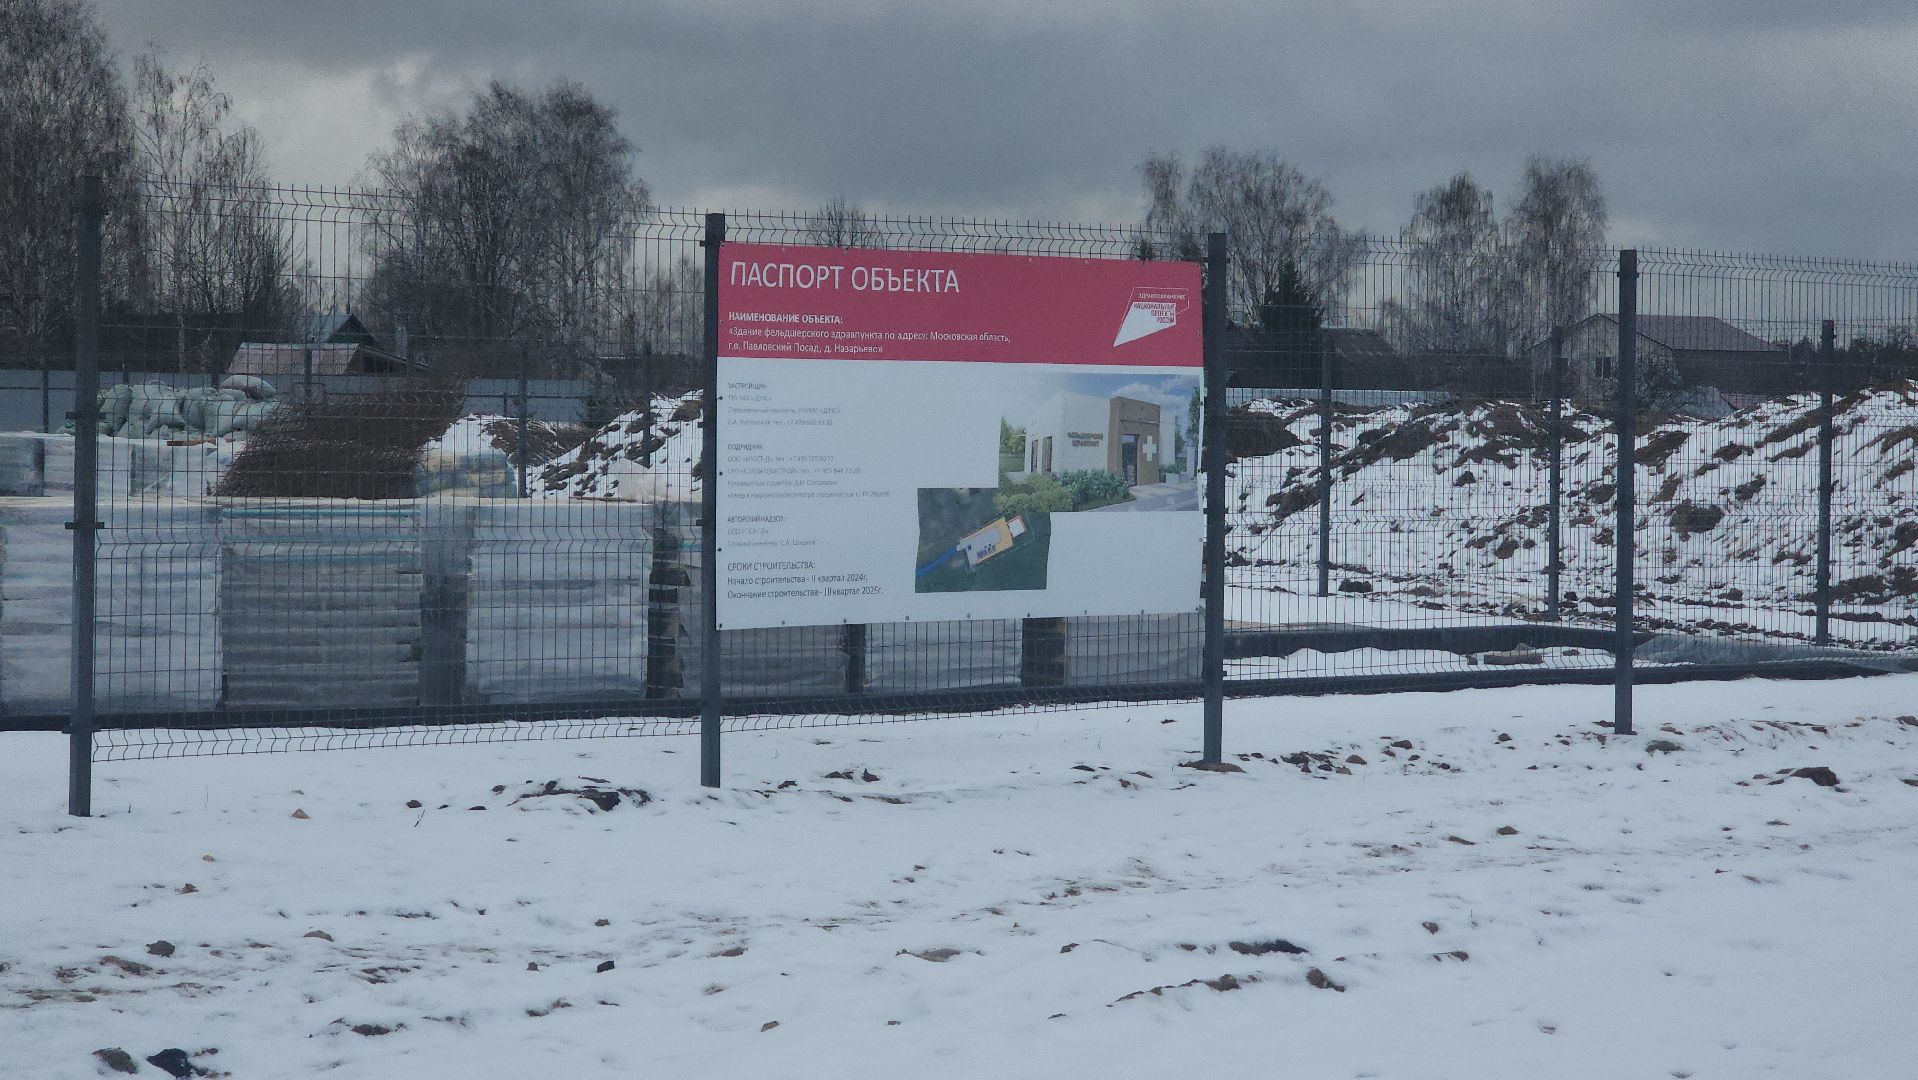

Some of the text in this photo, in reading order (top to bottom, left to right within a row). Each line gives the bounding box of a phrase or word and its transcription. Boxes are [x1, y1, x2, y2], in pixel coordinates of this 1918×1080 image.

[730, 260, 960, 293] ПАСПОРТ ОБЪЕКТА
[728, 312, 843, 324] НАИМЕНОВАНИЕ ОБЪЕКТА:
[728, 326, 1011, 343] «Здание фельдшерского здравпункта по адресу: Московская область,
[728, 341, 883, 355] г.о. Павловский Посад, д. Назарьево»
[727, 561, 816, 571] СРОКИ СТРОИТЕЛЬСТВА:
[728, 577, 753, 585] Начало
[754, 576, 806, 586] строительства
[818, 575, 845, 584] квартал
[727, 590, 766, 599] Окончание
[767, 589, 819, 598] строительства
[832, 588, 860, 597] квартал
